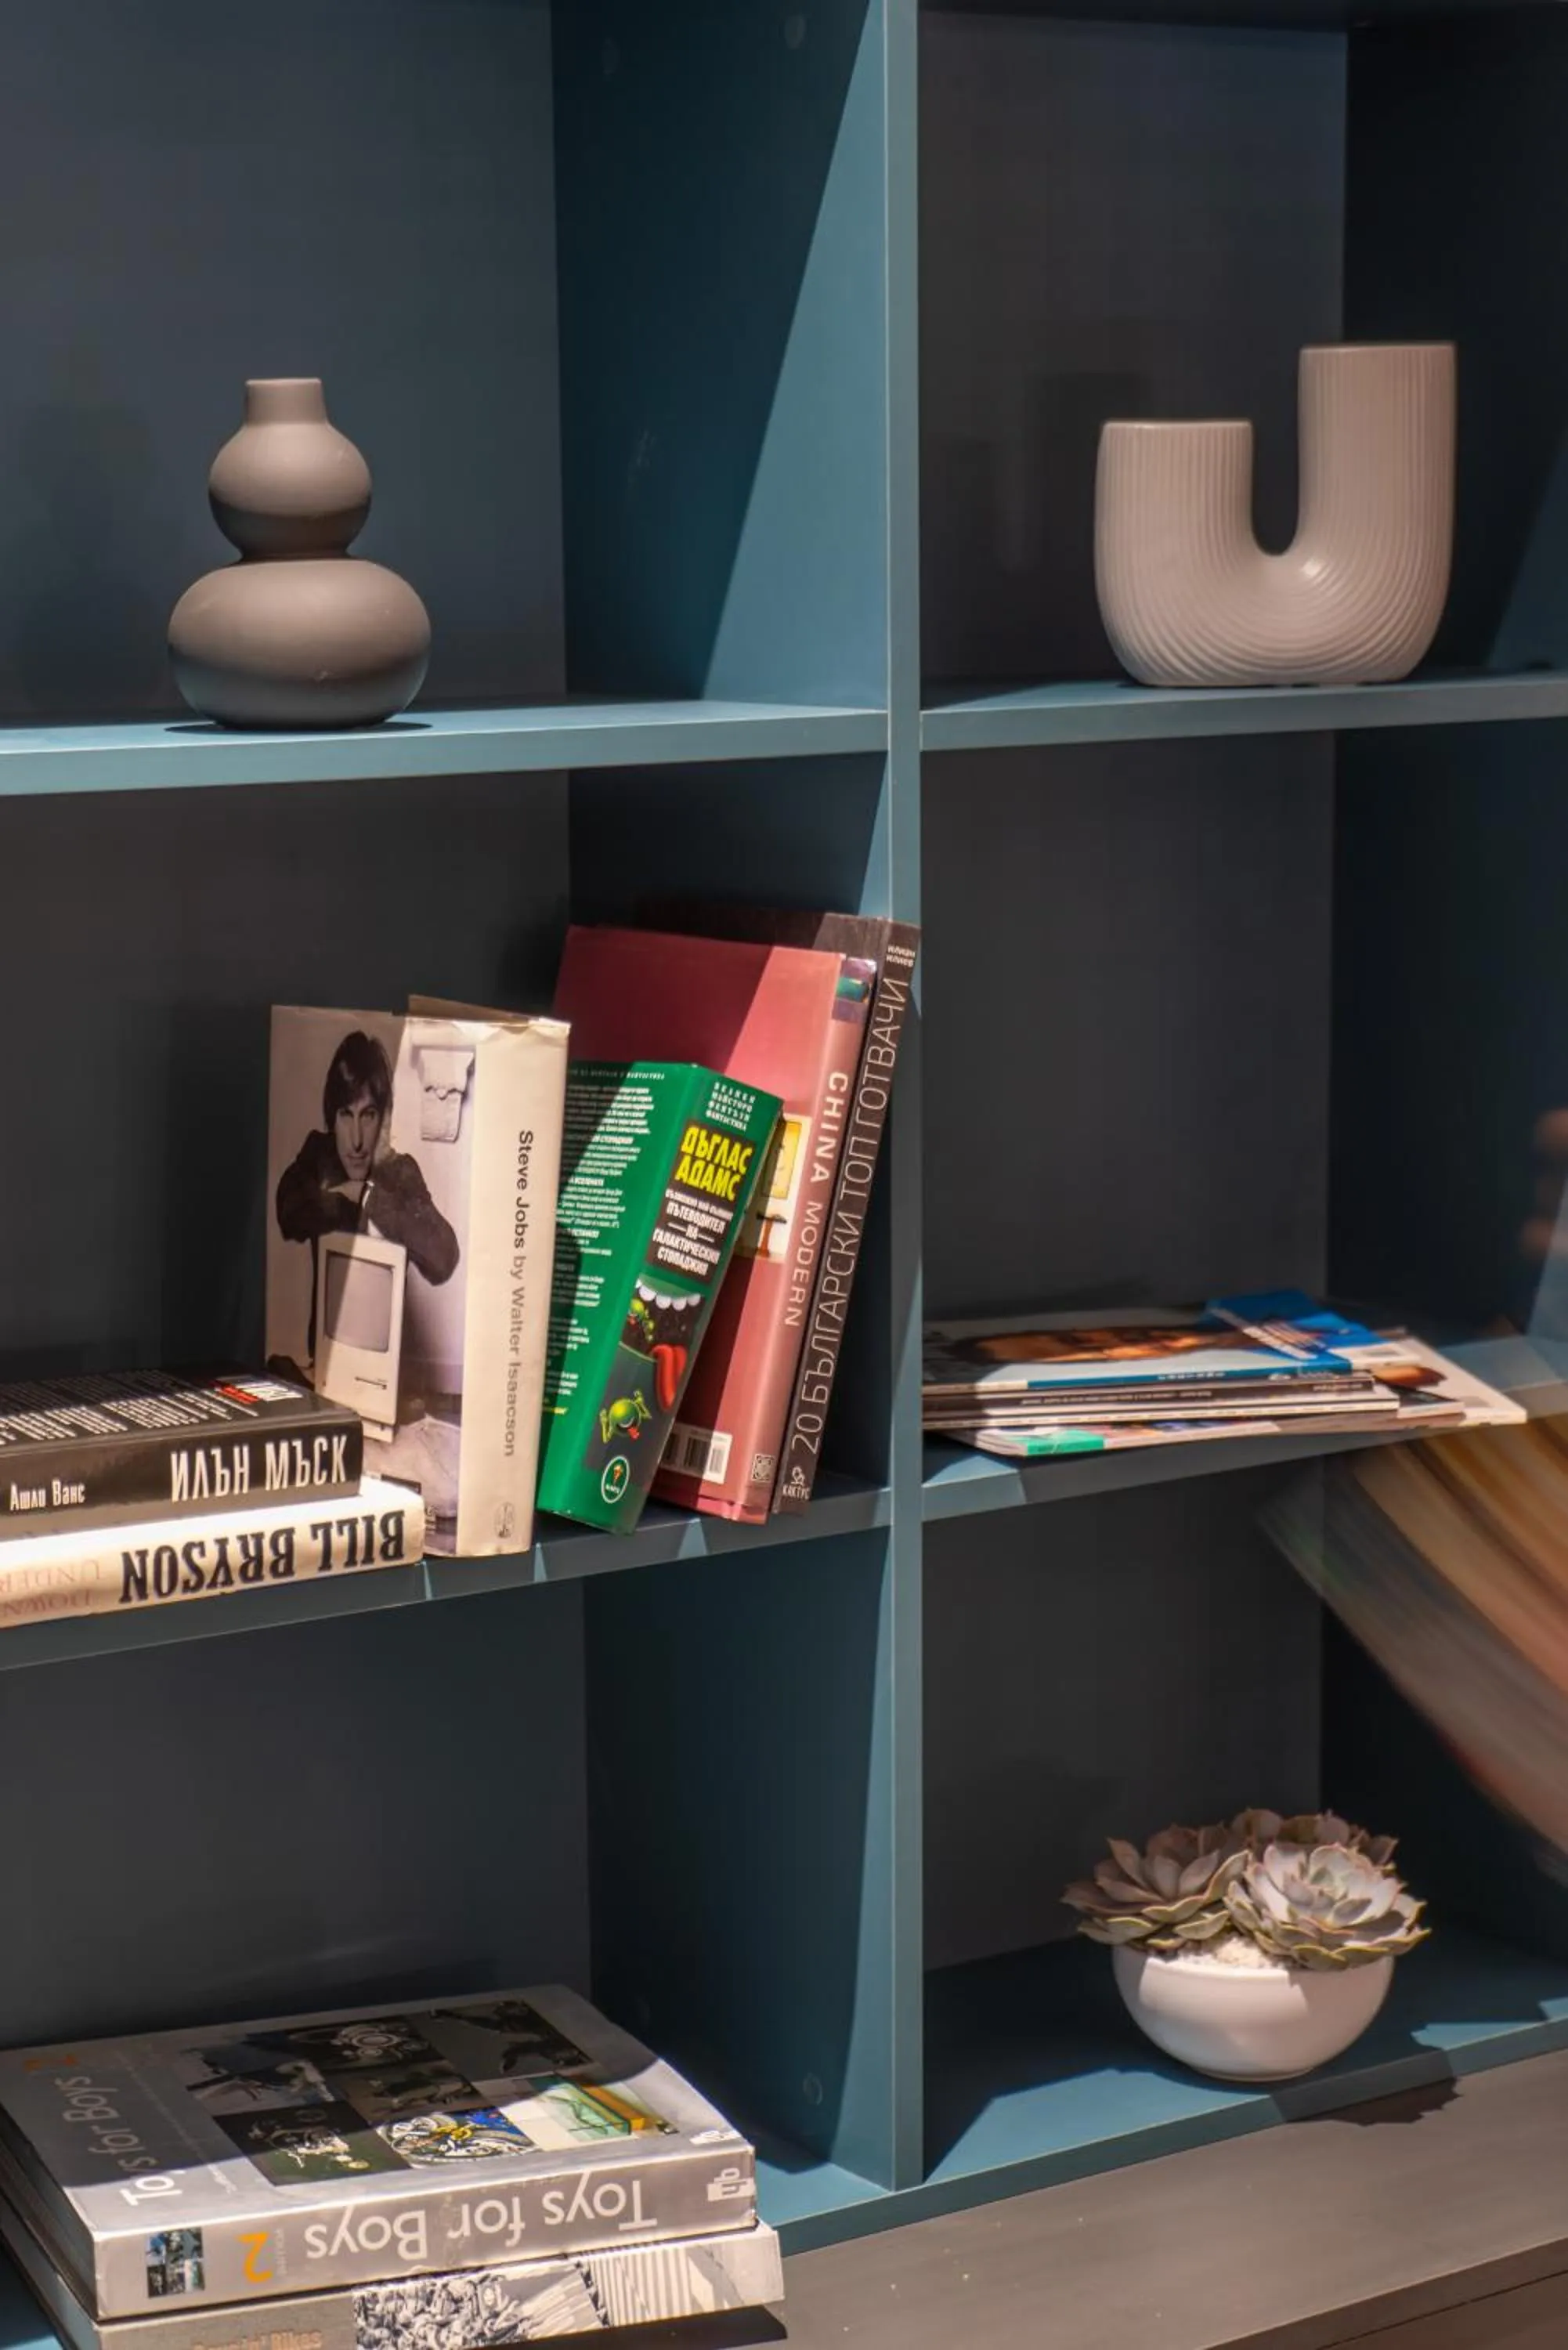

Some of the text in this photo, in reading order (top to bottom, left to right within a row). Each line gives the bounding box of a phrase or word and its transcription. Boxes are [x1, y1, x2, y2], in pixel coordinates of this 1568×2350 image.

[681, 1125, 753, 1175] ДЪГЛАС
[675, 1157, 741, 1202] АДАМС
[784, 1072, 848, 1326] CHINA MODERN
[792, 978, 909, 1454] 20 БЪЛГАРСКИ ТОП ГОТВАЧИ
[503, 1130, 534, 1458] Steve Jobs by Walter Isaacson
[10, 1478, 85, 1511] Ашли Ванс
[170, 1434, 347, 1502] ИЛЪН МЪСК
[118, 1527, 296, 1604] BRYSON
[310, 1509, 406, 1572] BILL
[54, 2075, 121, 2122] Boys
[88, 2125, 146, 2155] for
[119, 2155, 187, 2207] Toys
[544, 2171, 658, 2232] Toys
[305, 2204, 428, 2261] Boys
[447, 2194, 523, 2246] for
[238, 2232, 272, 2284] 2
